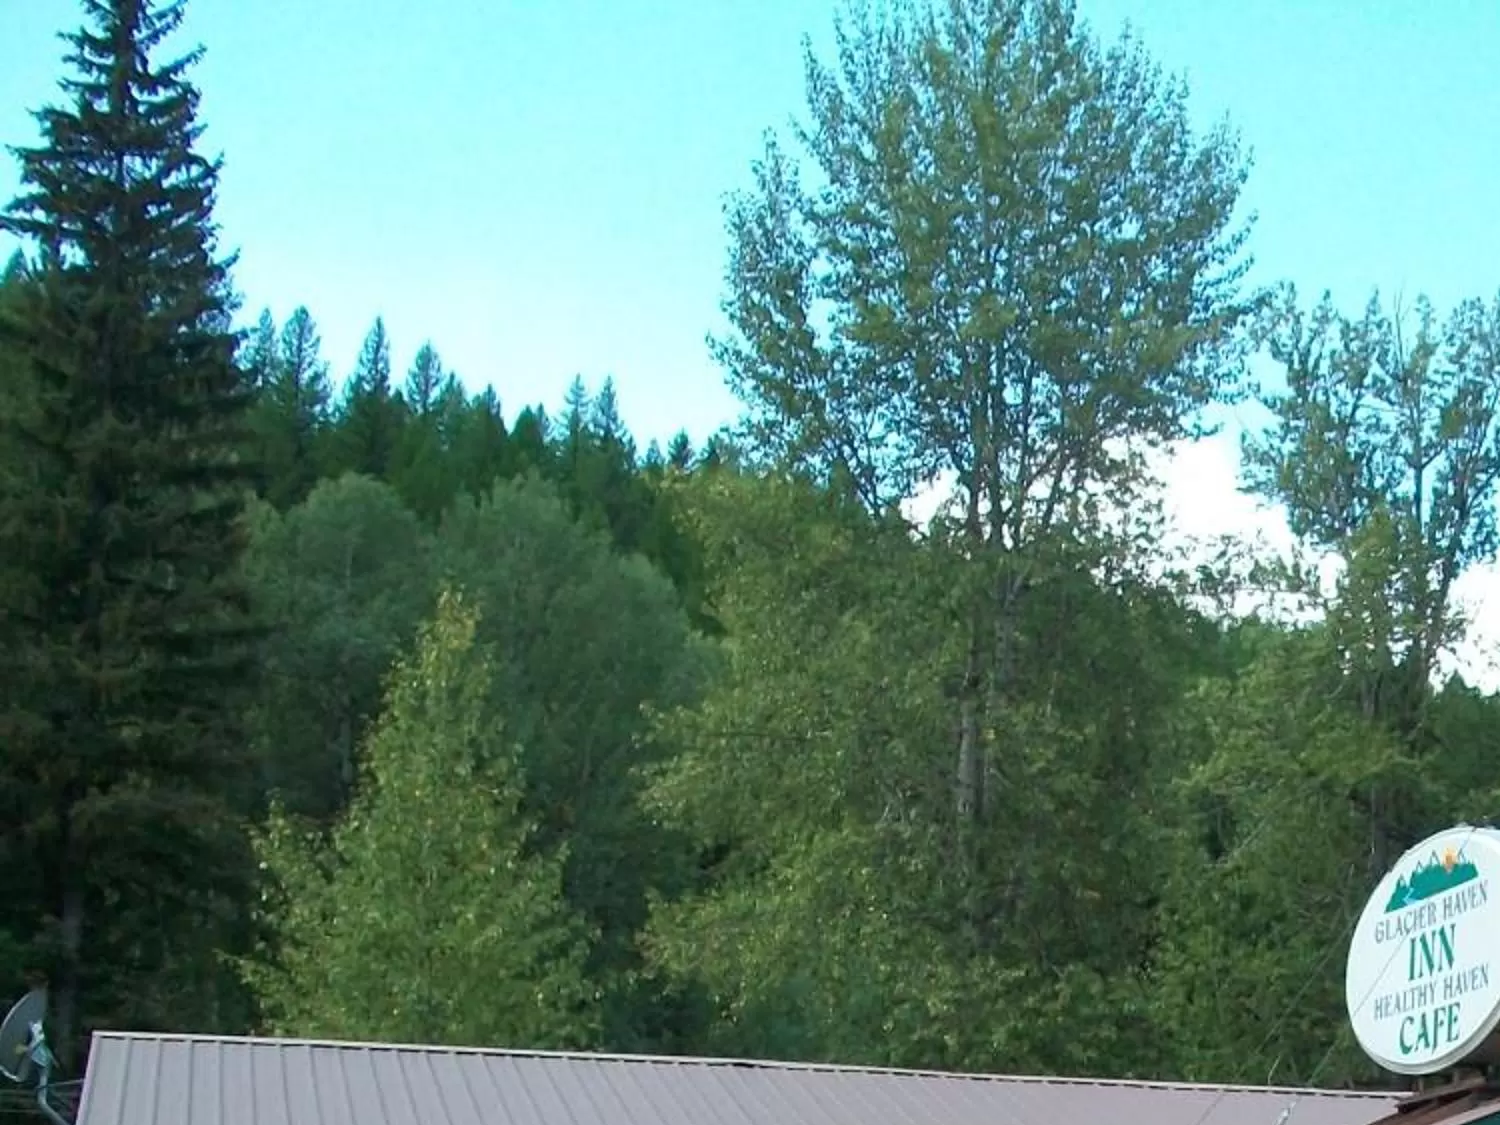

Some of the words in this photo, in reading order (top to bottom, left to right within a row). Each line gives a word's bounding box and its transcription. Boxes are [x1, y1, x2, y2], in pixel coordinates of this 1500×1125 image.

[1375, 905, 1438, 944] GLACIER
[1443, 879, 1489, 916] HAVEN
[1408, 922, 1457, 982] INN
[1374, 979, 1438, 1020] HEALTHY
[1443, 963, 1489, 1001] HAVEN
[1399, 1001, 1462, 1055] CAFE
